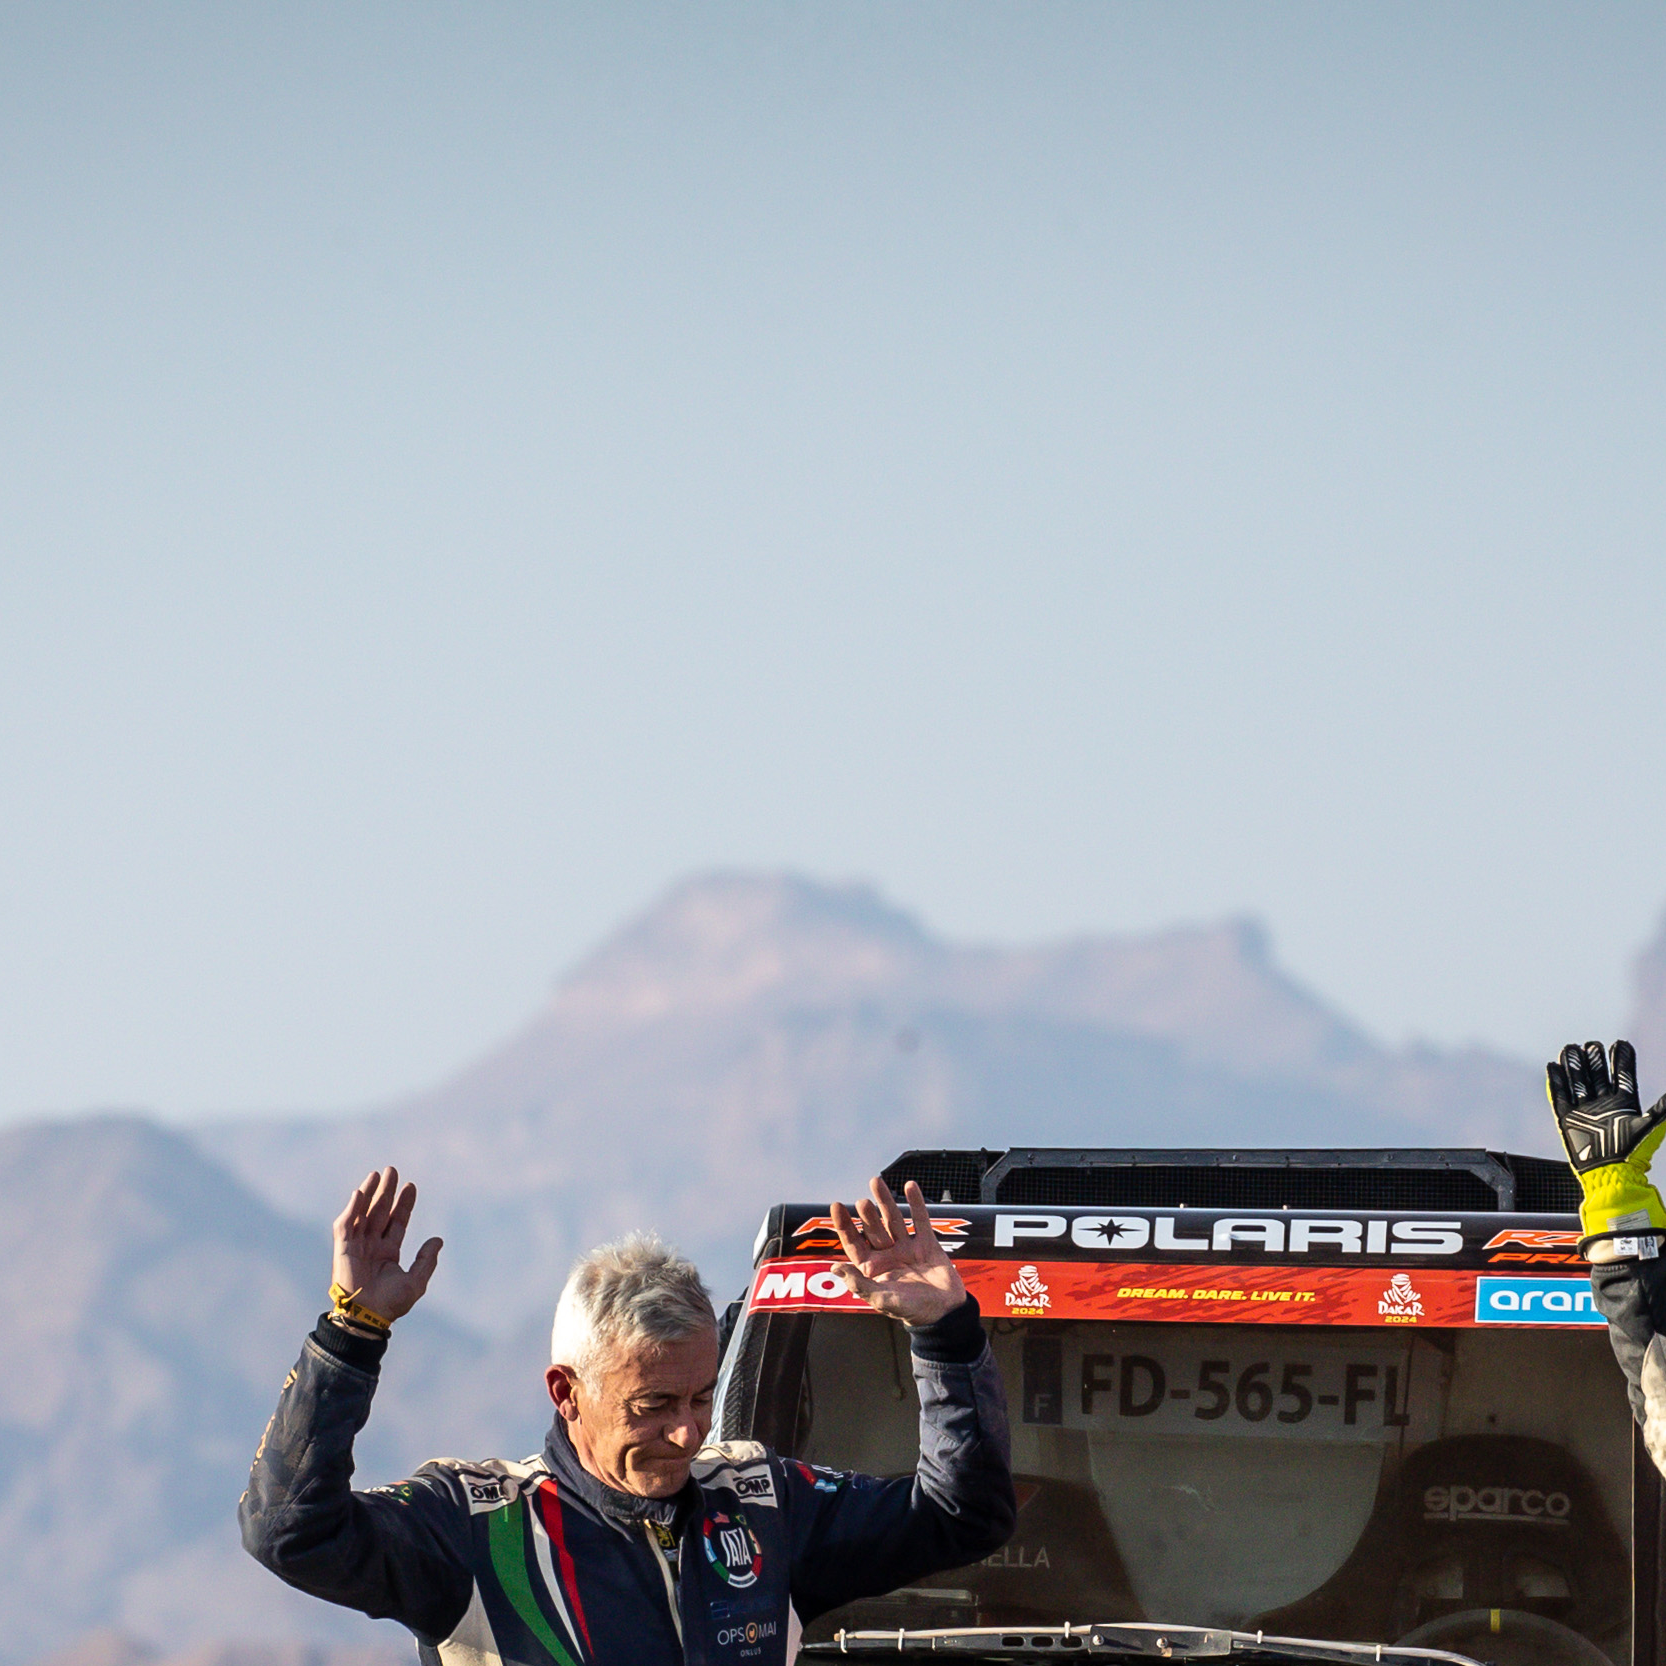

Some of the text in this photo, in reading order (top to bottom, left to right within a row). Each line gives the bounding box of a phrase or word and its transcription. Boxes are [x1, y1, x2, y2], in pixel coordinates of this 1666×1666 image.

[994, 1213, 1464, 1254] POLARIS
[1116, 1287, 1316, 1302] DREAM. DARE. LIVE IT.
[1011, 1307, 1045, 1316] 2024
[1384, 1315, 1418, 1324] 2024
[1081, 1354, 1411, 1428] FD-565-FL
[735, 1476, 771, 1496] OMP
